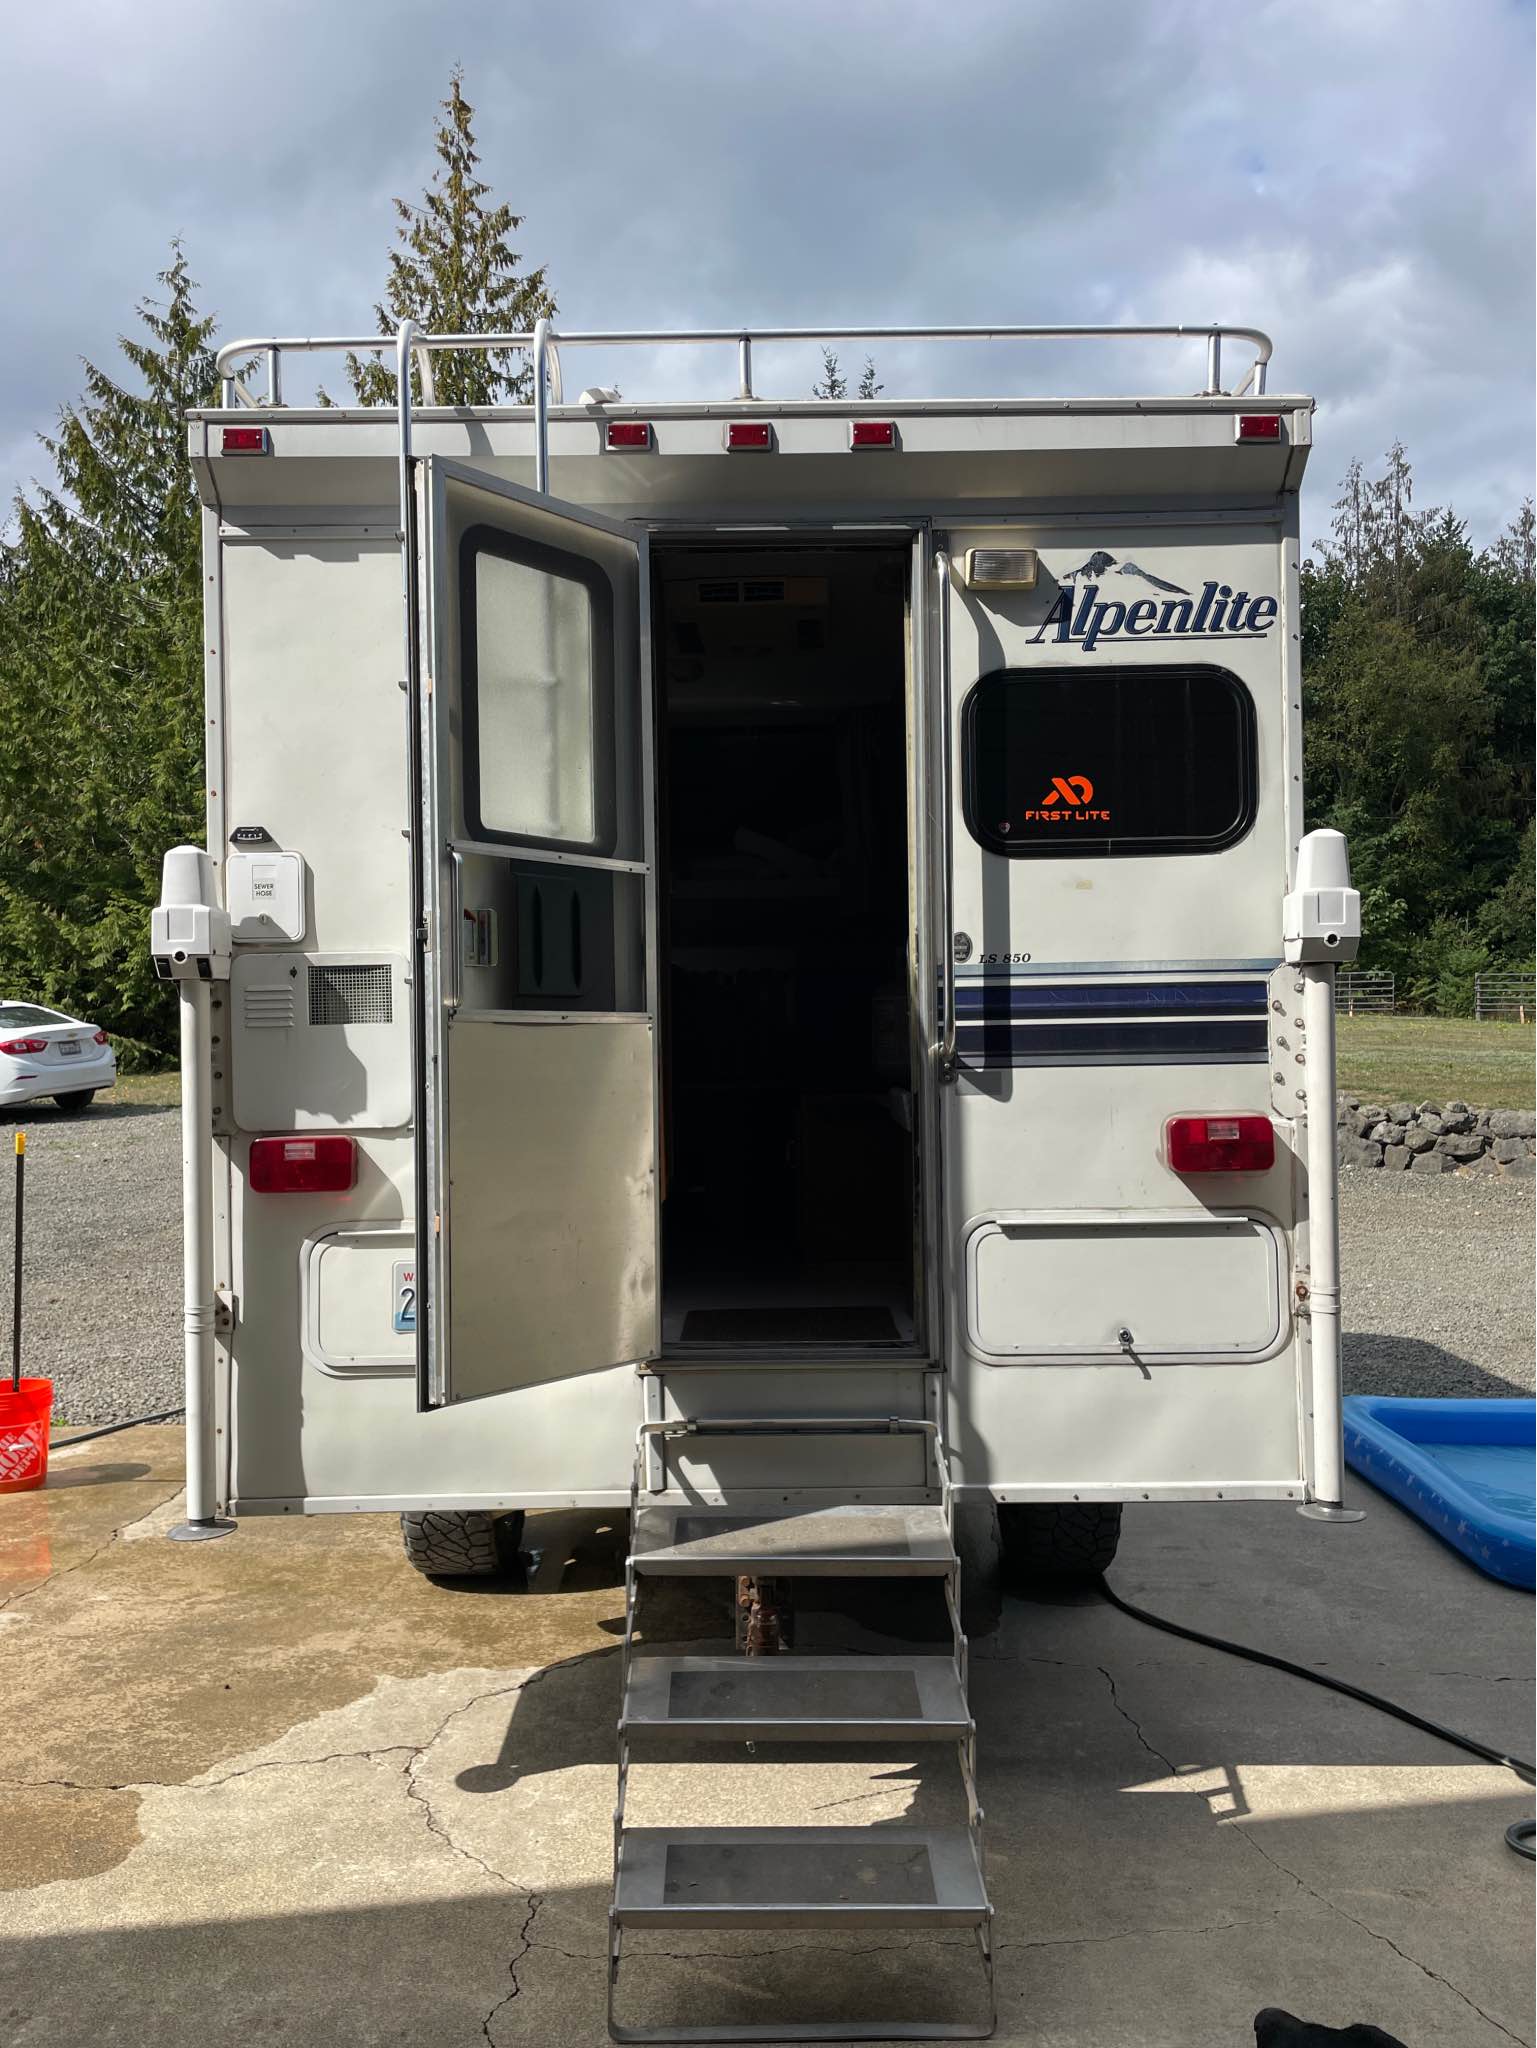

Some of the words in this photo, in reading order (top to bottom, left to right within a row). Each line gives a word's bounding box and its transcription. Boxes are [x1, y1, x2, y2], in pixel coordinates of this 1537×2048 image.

[1025, 581, 1278, 652] Alpenlite
[1025, 810, 1072, 821] FIRST
[1075, 810, 1110, 820] LITE
[979, 953, 998, 964] LS
[1002, 952, 1032, 964] 850
[0, 1432, 17, 1450] HE
